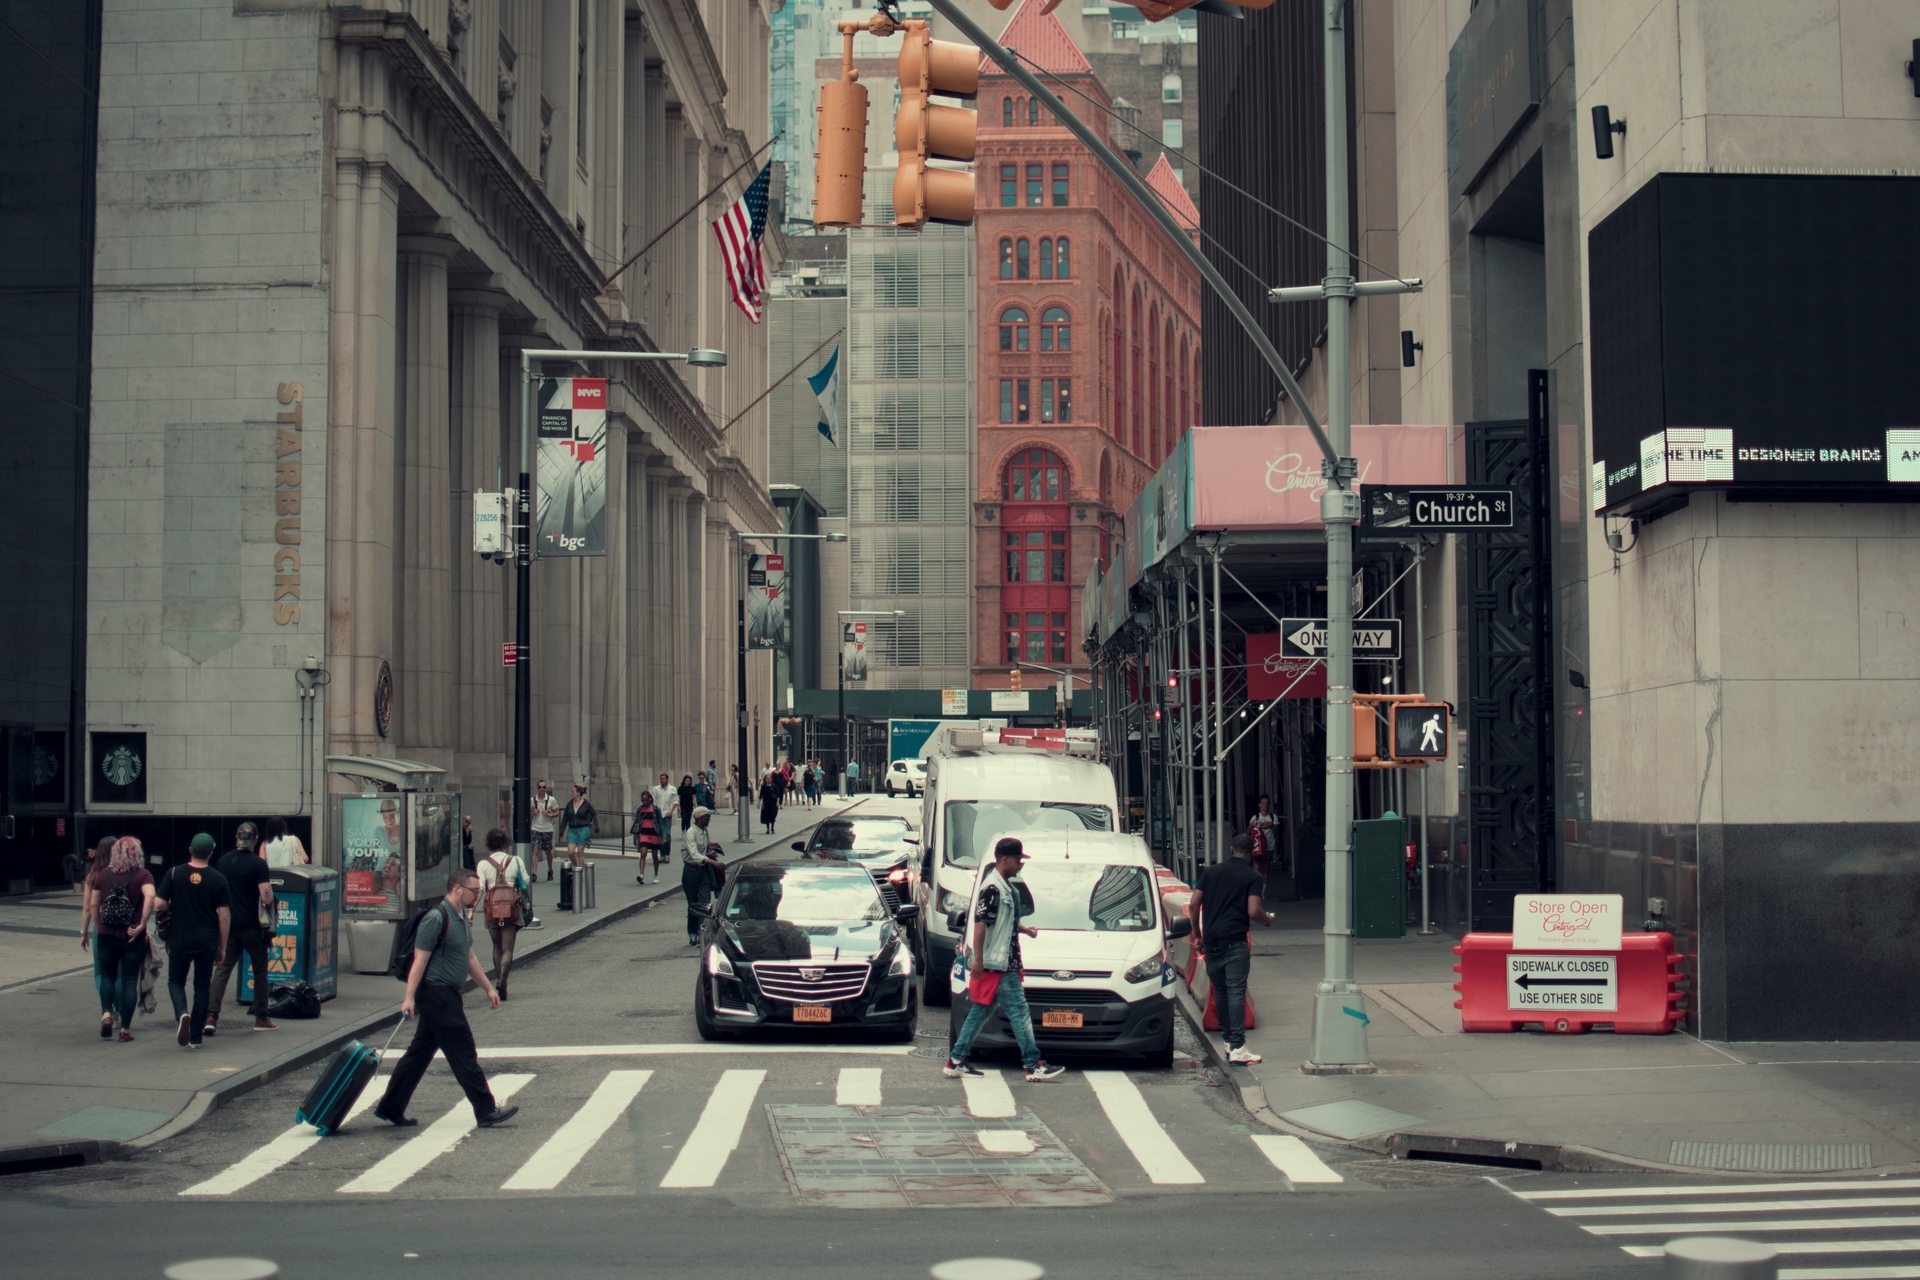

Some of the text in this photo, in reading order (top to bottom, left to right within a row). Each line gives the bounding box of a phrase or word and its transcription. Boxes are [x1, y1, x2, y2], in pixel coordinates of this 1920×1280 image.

[577, 388, 601, 397] NYC
[1689, 448, 1724, 460] TIME
[1738, 448, 1882, 462] DESIGNER BRANDS
[1446, 493, 1465, 502] 19-37
[274, 382, 303, 625] STARBUCKS
[1416, 500, 1506, 522] Church St
[476, 514, 498, 522] 726256
[559, 534, 586, 551] bgc
[760, 636, 774, 647] bgc
[347, 828, 376, 838] SAVE
[347, 838, 381, 848] YOUR
[347, 848, 389, 857] YOUTH
[1528, 900, 1608, 916] Store Open
[1543, 914, 1593, 937] Century 21
[1512, 960, 1609, 972] SIDEWALK CLOSED
[1519, 993, 1604, 1004] USE OTHER SIDE
